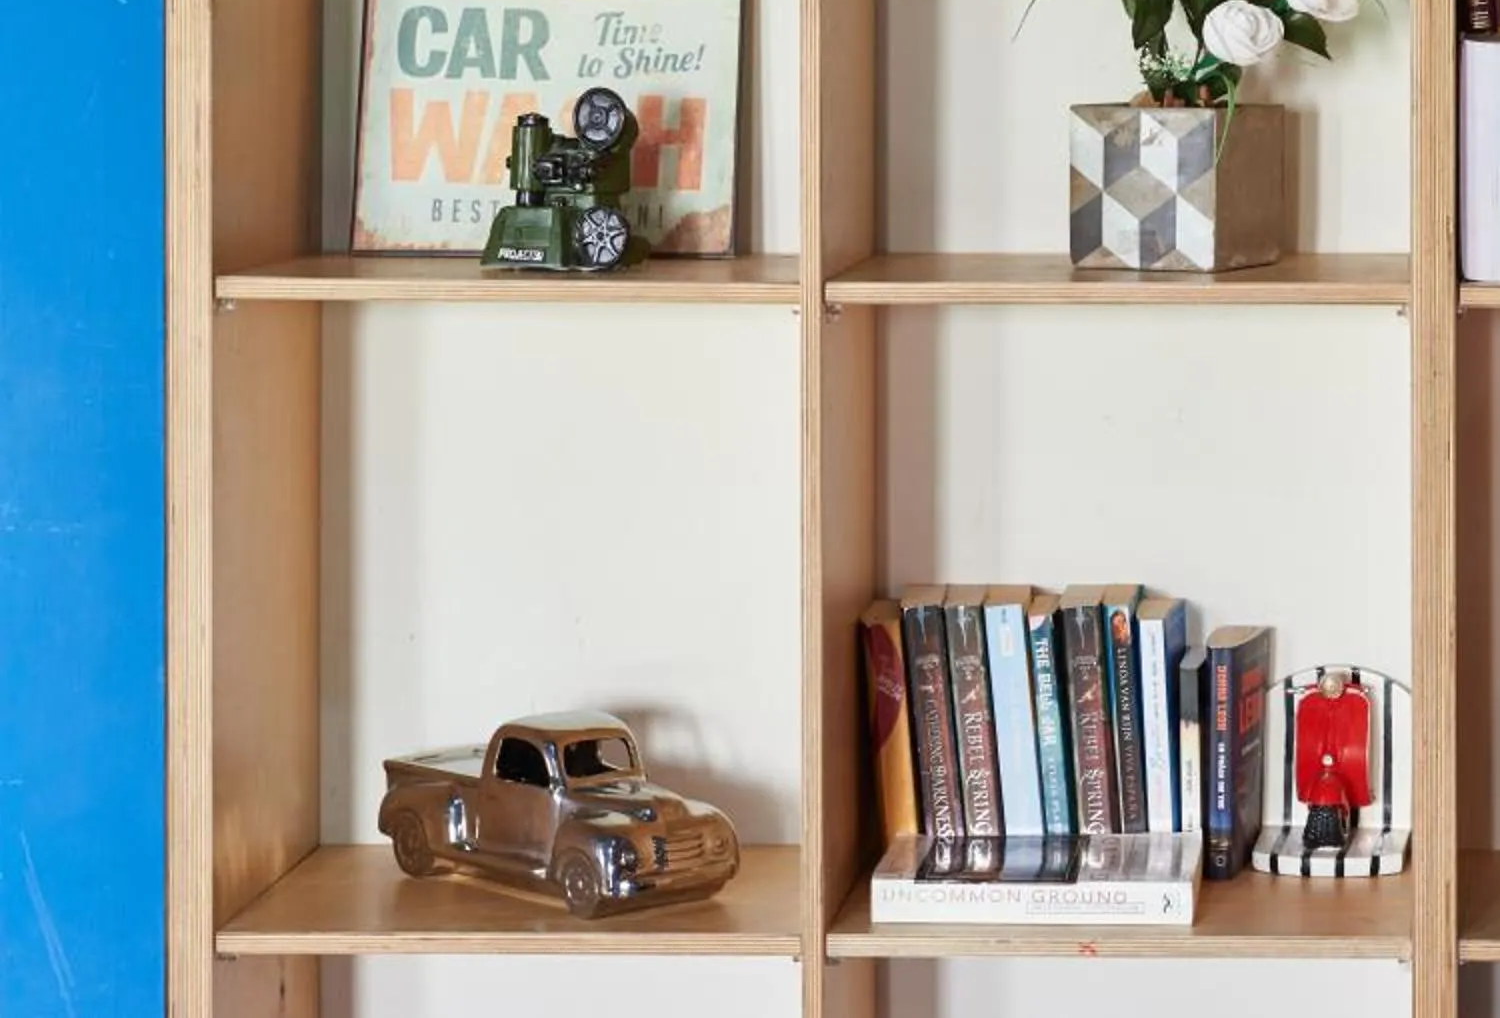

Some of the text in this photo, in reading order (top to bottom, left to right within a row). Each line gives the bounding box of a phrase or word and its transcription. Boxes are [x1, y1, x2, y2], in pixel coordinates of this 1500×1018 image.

[397, 6, 551, 81] CAR
[577, 45, 706, 80] to Shine!
[593, 11, 662, 47] Time
[389, 87, 708, 191] WAH
[1035, 638, 1058, 746] THE BELL JAR
[1119, 682, 1131, 712] VAN
[964, 713, 993, 835] REBEL SPRING
[1080, 712, 1106, 836] REBEL SPRING
[880, 888, 1129, 905] UNCOMMON GROUND
